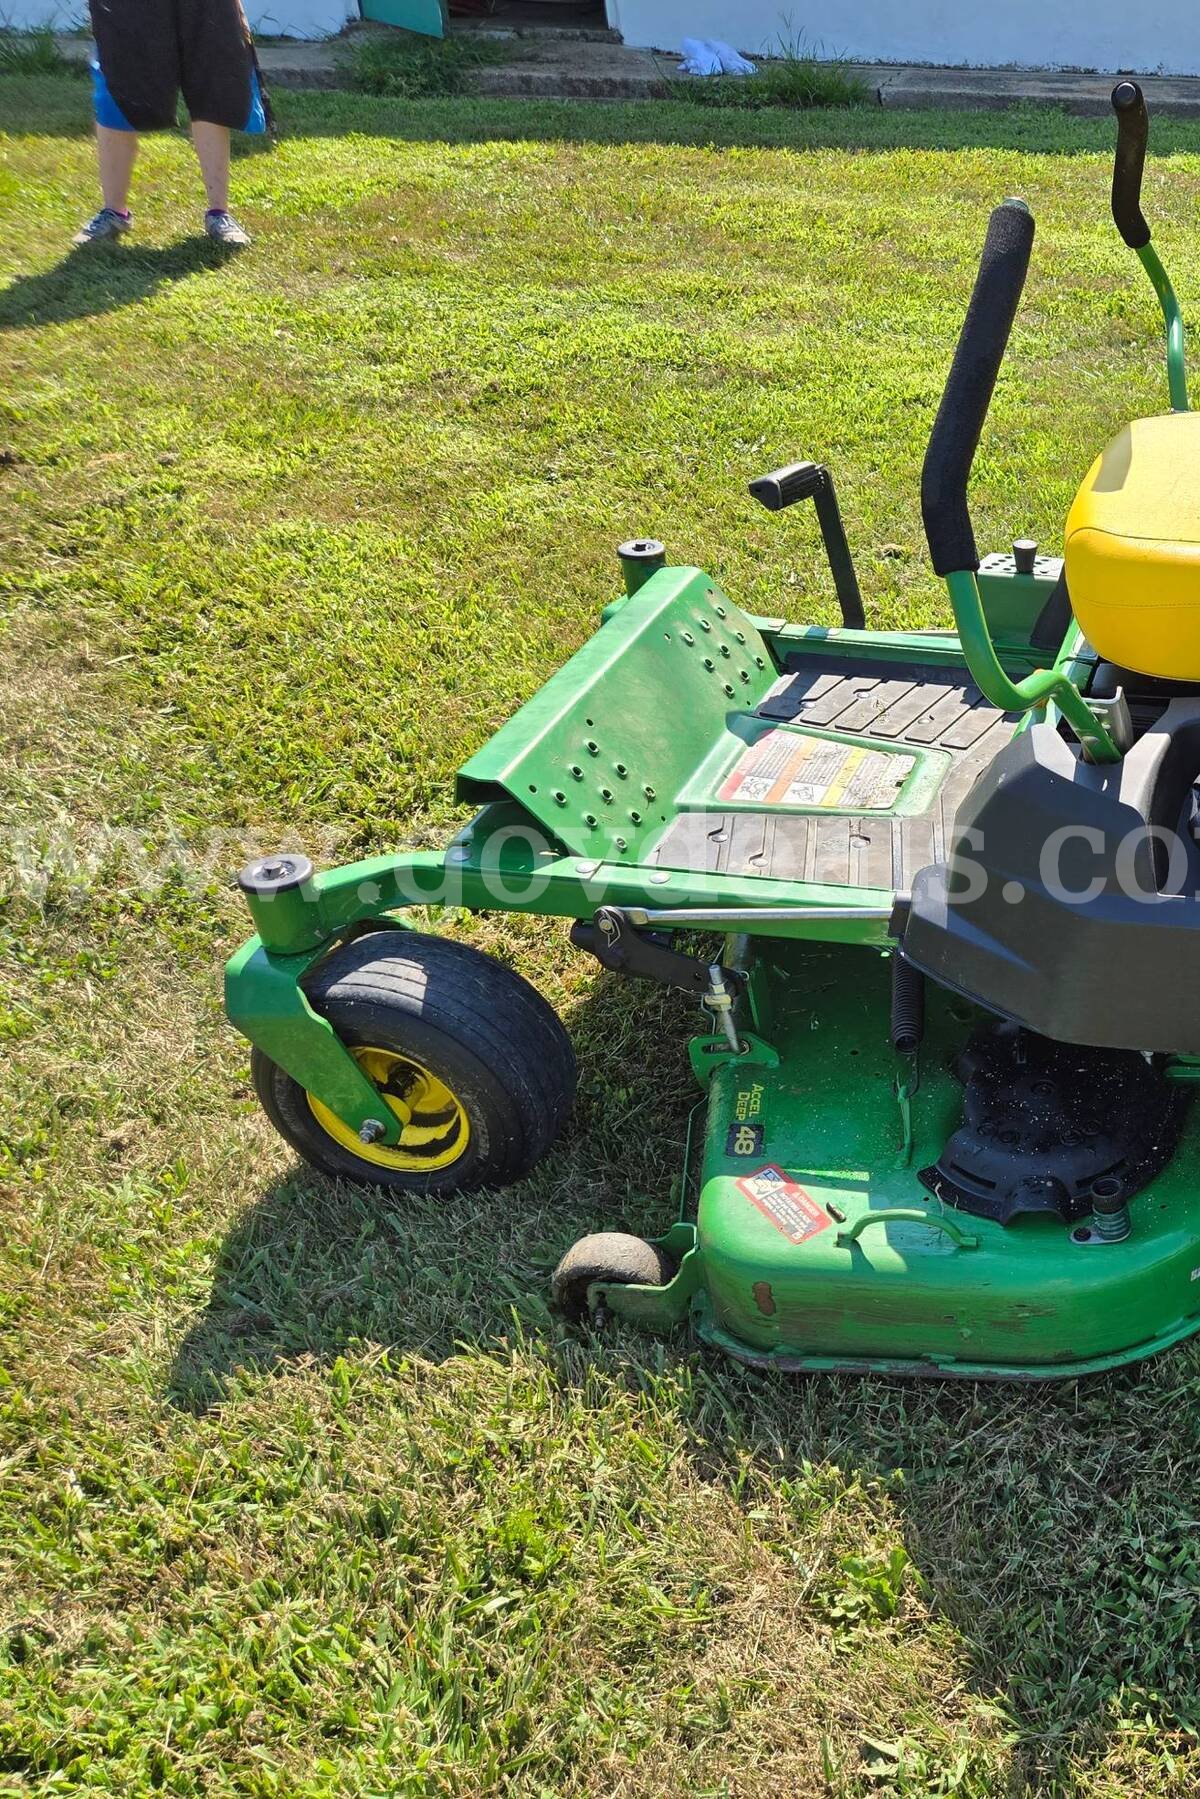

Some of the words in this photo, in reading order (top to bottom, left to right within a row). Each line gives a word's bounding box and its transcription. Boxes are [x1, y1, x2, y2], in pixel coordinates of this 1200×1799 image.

[736, 1092, 750, 1120] DEEP
[749, 1083, 764, 1117] ACCEL
[734, 1126, 756, 1155] 48
